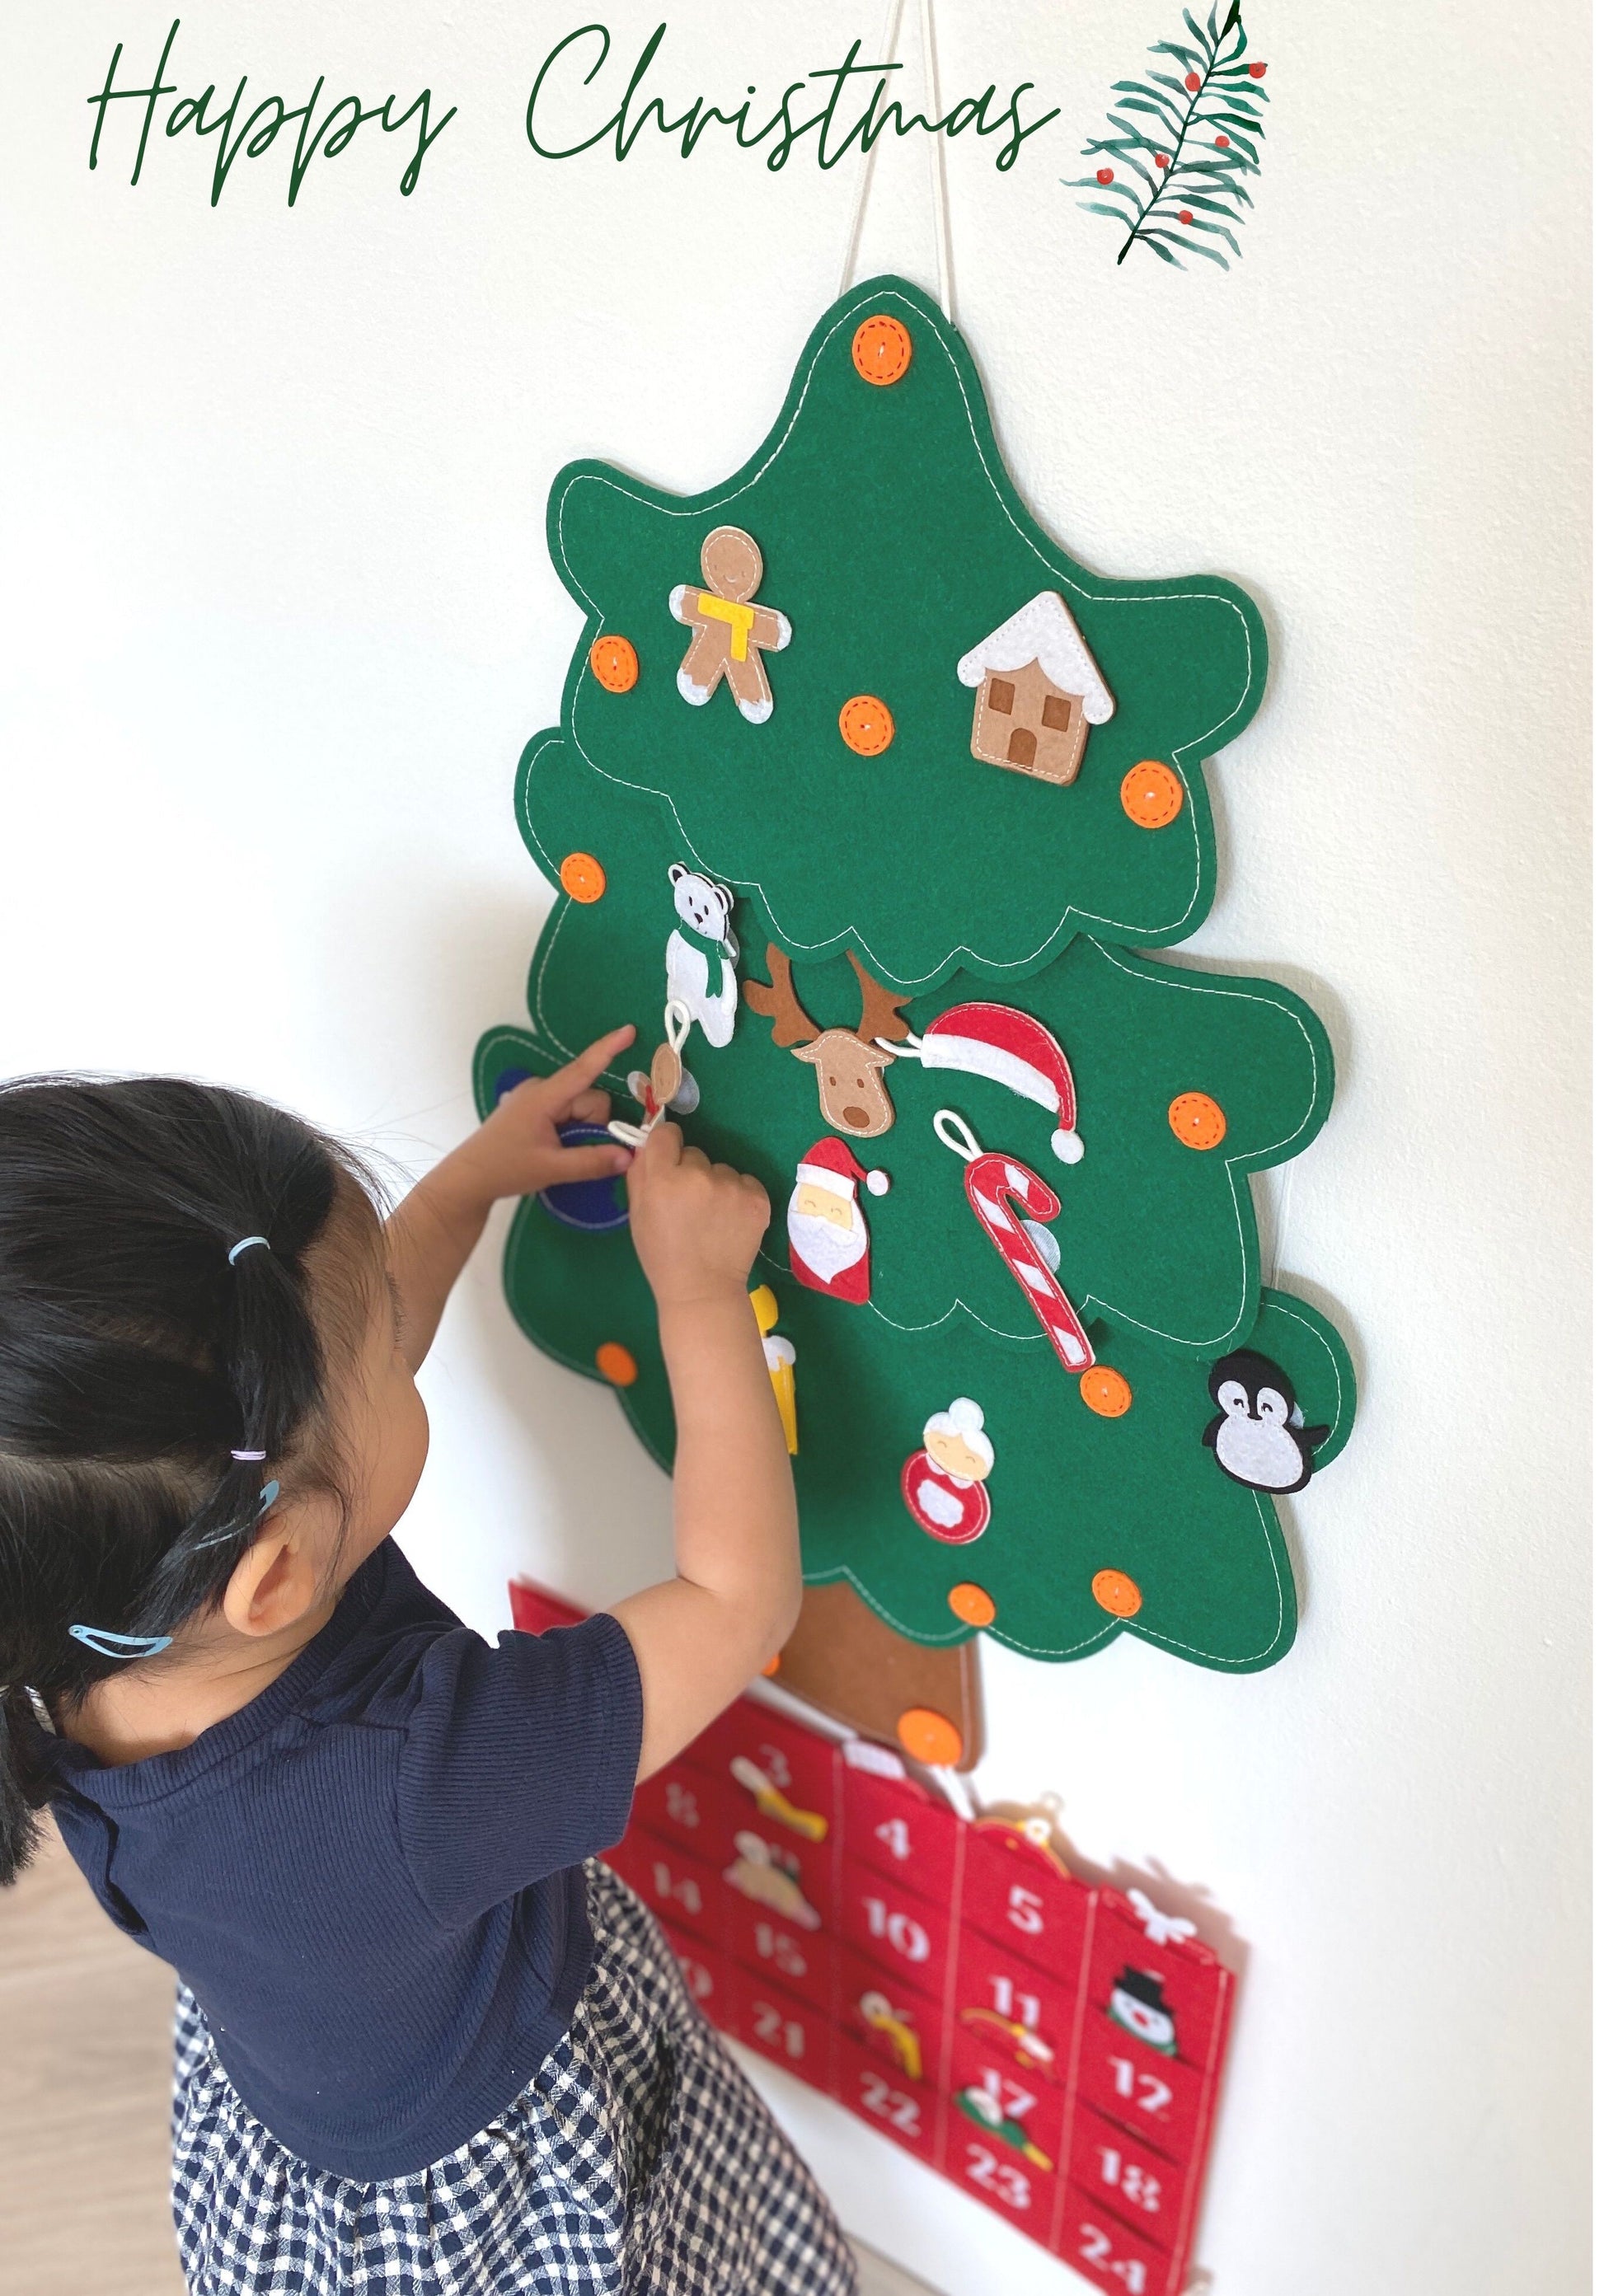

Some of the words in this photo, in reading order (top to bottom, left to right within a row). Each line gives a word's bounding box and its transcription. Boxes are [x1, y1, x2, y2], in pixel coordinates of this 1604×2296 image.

[875, 1818, 911, 1860] 4
[864, 1897, 931, 1963] 10
[1006, 1884, 1044, 1935] 5
[991, 1975, 1040, 2031] 11
[858, 2071, 922, 2138] 22
[1109, 2056, 1174, 2113] 12
[966, 2143, 1032, 2210] 23
[1099, 2146, 1162, 2214] 18
[1080, 2223, 1147, 2296] 24
